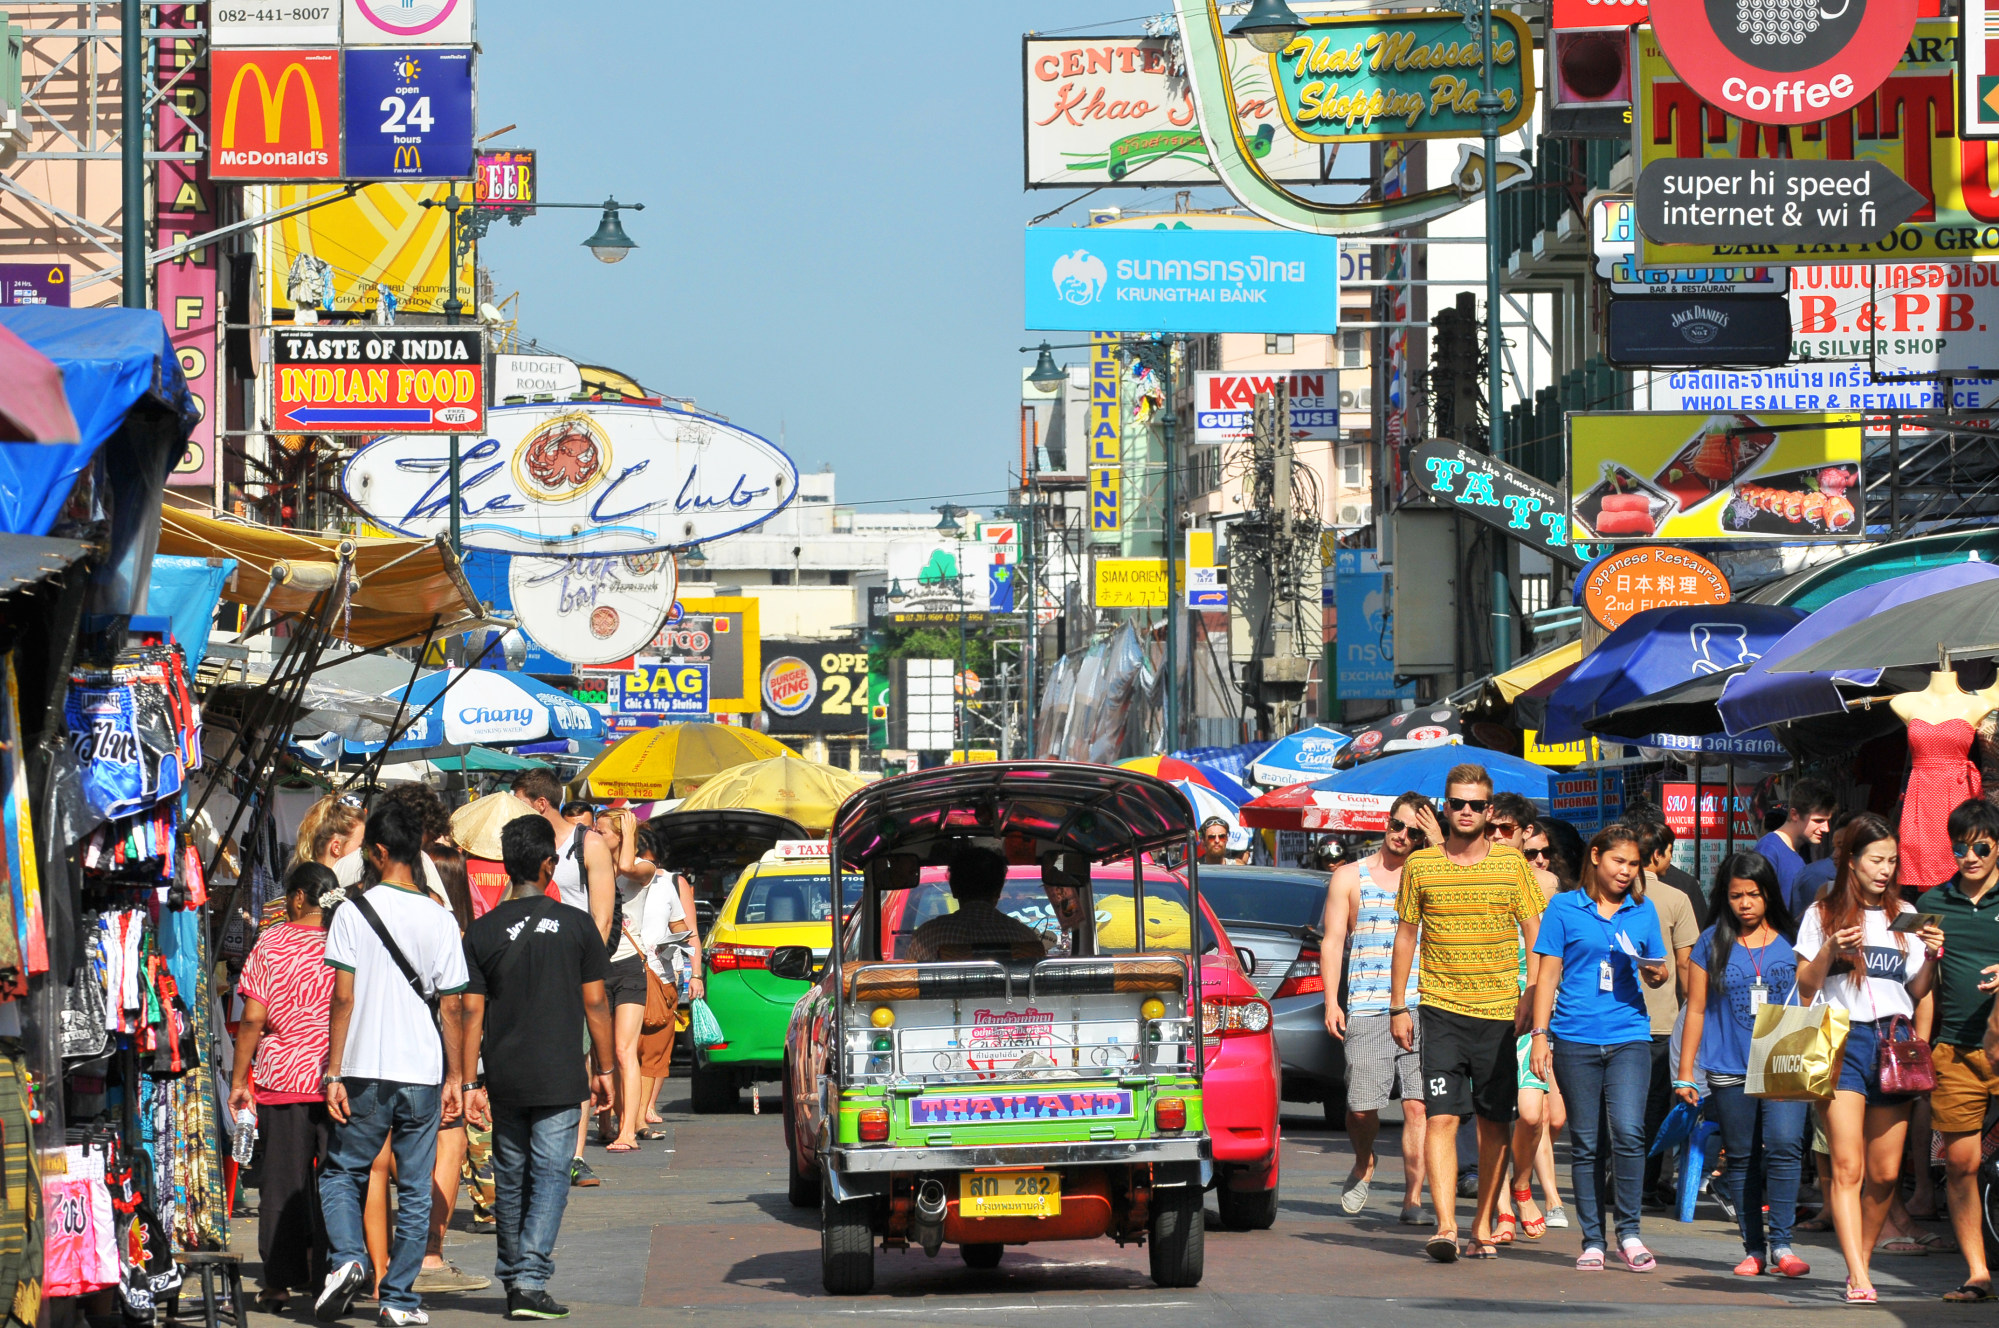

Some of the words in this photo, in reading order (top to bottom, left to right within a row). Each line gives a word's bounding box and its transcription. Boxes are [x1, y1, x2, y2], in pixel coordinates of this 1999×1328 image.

[218, 7, 330, 23] 082-441-8007
[1283, 36, 1363, 78] Thai
[395, 86, 419, 95] open
[1721, 72, 1854, 112] coffee
[1034, 81, 1158, 126] Khao
[1297, 80, 1426, 130] Shopping
[1430, 75, 1517, 117] Plaa
[379, 96, 435, 133] 24
[393, 135, 422, 144] hours
[220, 150, 328, 166] McDonald's
[475, 164, 532, 201] BEER
[1663, 174, 1740, 201] super
[1749, 170, 1775, 195] hi
[1786, 171, 1870, 202] speed
[1662, 201, 1775, 227] internet
[1781, 202, 1803, 227] &
[1816, 203, 1848, 227] wi
[1859, 201, 1877, 227] fi
[1115, 255, 1305, 289] ธนาคารกรุงไทย
[1116, 287, 1215, 302] KRUNGTHAI
[1219, 288, 1267, 303] BANK
[1682, 285, 1736, 293] RESTAURANT
[1671, 308, 1694, 328] JACK
[1694, 305, 1730, 328] DANIEL'S
[286, 339, 360, 360] TASTE
[365, 339, 396, 360] OF
[401, 339, 469, 360] INDIA
[1818, 339, 1889, 356] SILVER
[1894, 338, 1947, 355] SHOP
[511, 361, 565, 374] BUDGET
[280, 368, 390, 403] INDIAN
[396, 368, 475, 404] FOOD
[516, 378, 556, 390] ROOM
[1209, 375, 1324, 409] KAWIN
[1682, 395, 1819, 410] WHOLESALER
[1826, 395, 1841, 409] &
[1850, 393, 1918, 409] RETAIL
[1920, 391, 1980, 408] PRCE
[444, 413, 466, 422] Wifi
[395, 438, 525, 527] The
[589, 458, 770, 524] Club
[1457, 449, 1477, 466] See
[1481, 460, 1501, 477] the
[1503, 472, 1556, 506] Amazing
[1094, 470, 1117, 529] INN
[1101, 571, 1128, 584] SIAM
[1130, 569, 1181, 583] ORIENTL
[1589, 553, 1648, 596] Japanese
[1654, 549, 1726, 600] Restaurant
[1616, 574, 1698, 595] 日本料理
[1604, 595, 1634, 612] 2nd
[821, 653, 868, 674] OPE
[625, 668, 703, 693] BAG
[770, 668, 807, 687] BURGER
[772, 678, 809, 702] KING
[624, 698, 642, 710] Chic
[643, 699, 651, 709] &
[652, 698, 670, 711] Trip
[672, 698, 703, 710] Station
[459, 706, 533, 727] Chang
[502, 726, 523, 734] WATER
[1295, 751, 1335, 764] Chan
[607, 788, 626, 797] Call
[633, 788, 653, 798] 1126
[1556, 778, 1614, 795] TOURIT
[1337, 793, 1380, 805] Chang
[1553, 793, 1620, 810] INFORMAION
[1666, 795, 1688, 812] SAO
[1666, 816, 1695, 825] MANICURE
[798, 844, 831, 856] TAXI
[1430, 1076, 1448, 1097] 52
[920, 1092, 1122, 1122] THAILAND
[1014, 1176, 1051, 1196] 282
[975, 1201, 1046, 1214] กรุงเทพมหานคร
